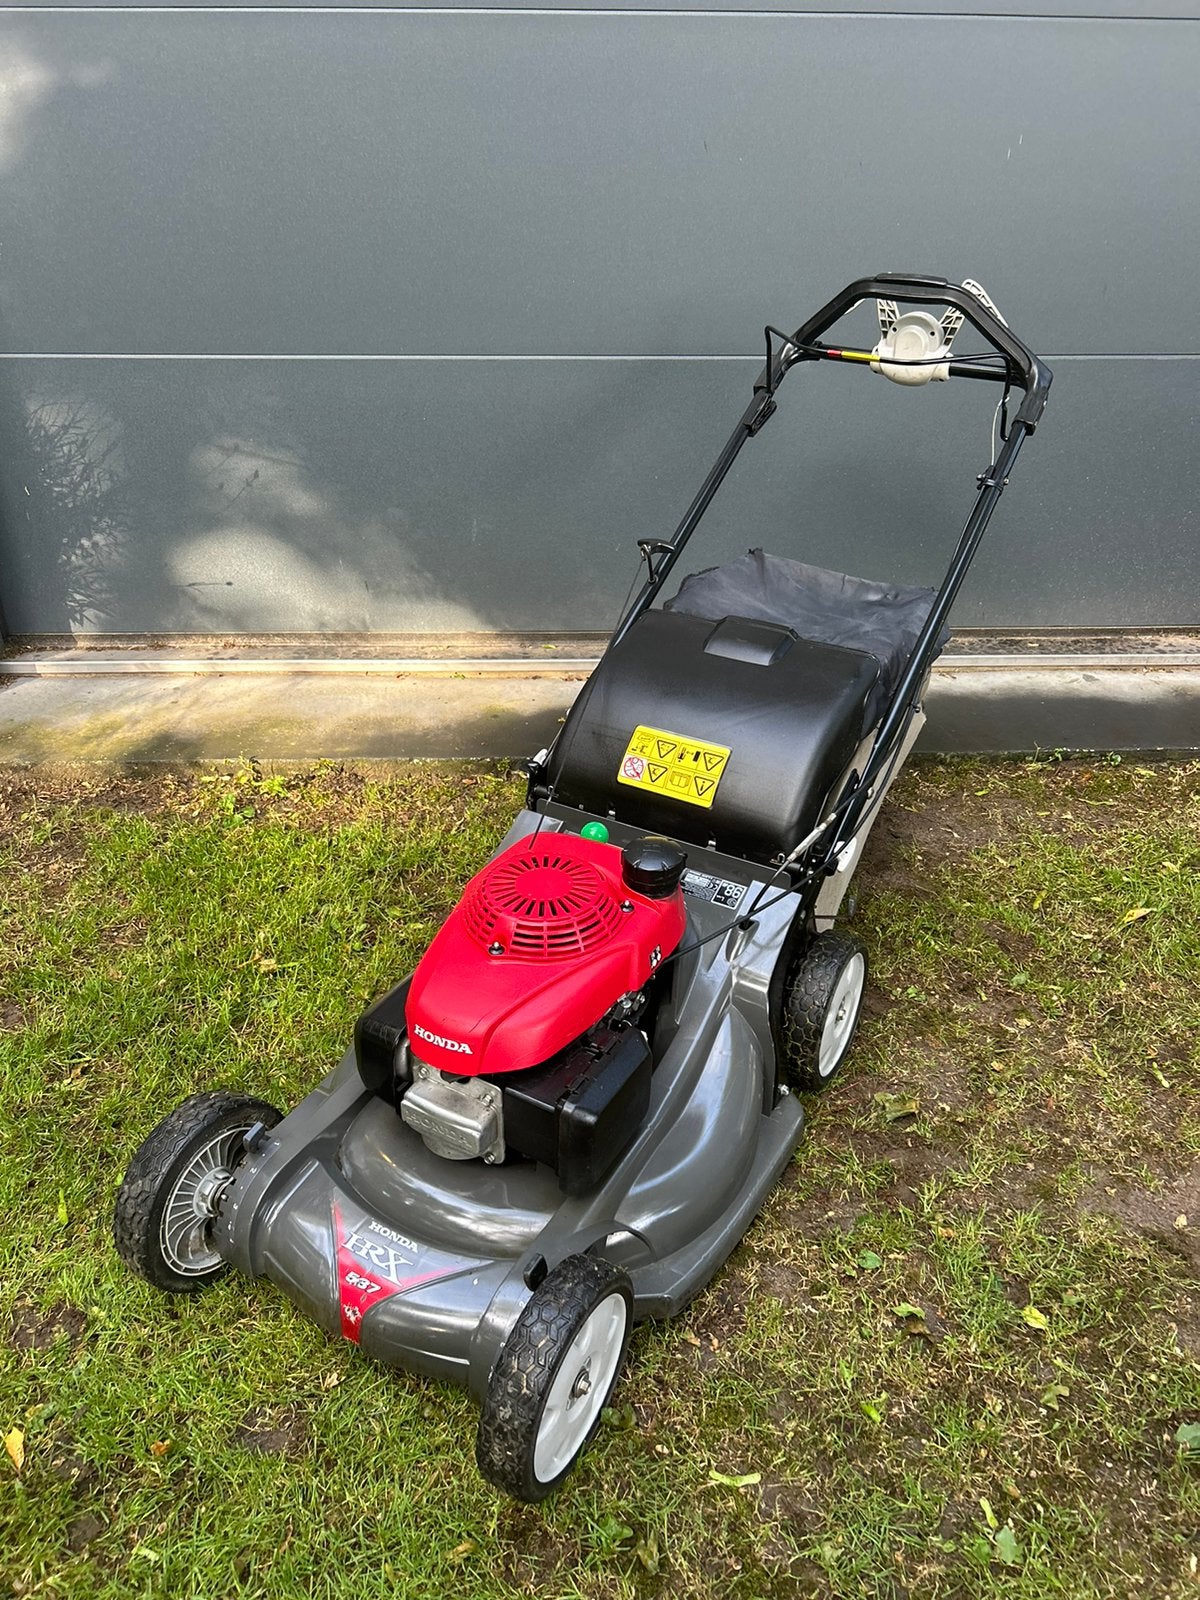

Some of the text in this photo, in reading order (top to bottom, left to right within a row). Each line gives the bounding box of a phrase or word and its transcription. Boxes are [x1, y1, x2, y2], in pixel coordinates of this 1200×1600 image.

[414, 1024, 473, 1054] HONDA
[368, 1220, 418, 1253] HONDA
[342, 1232, 413, 1286] HRX
